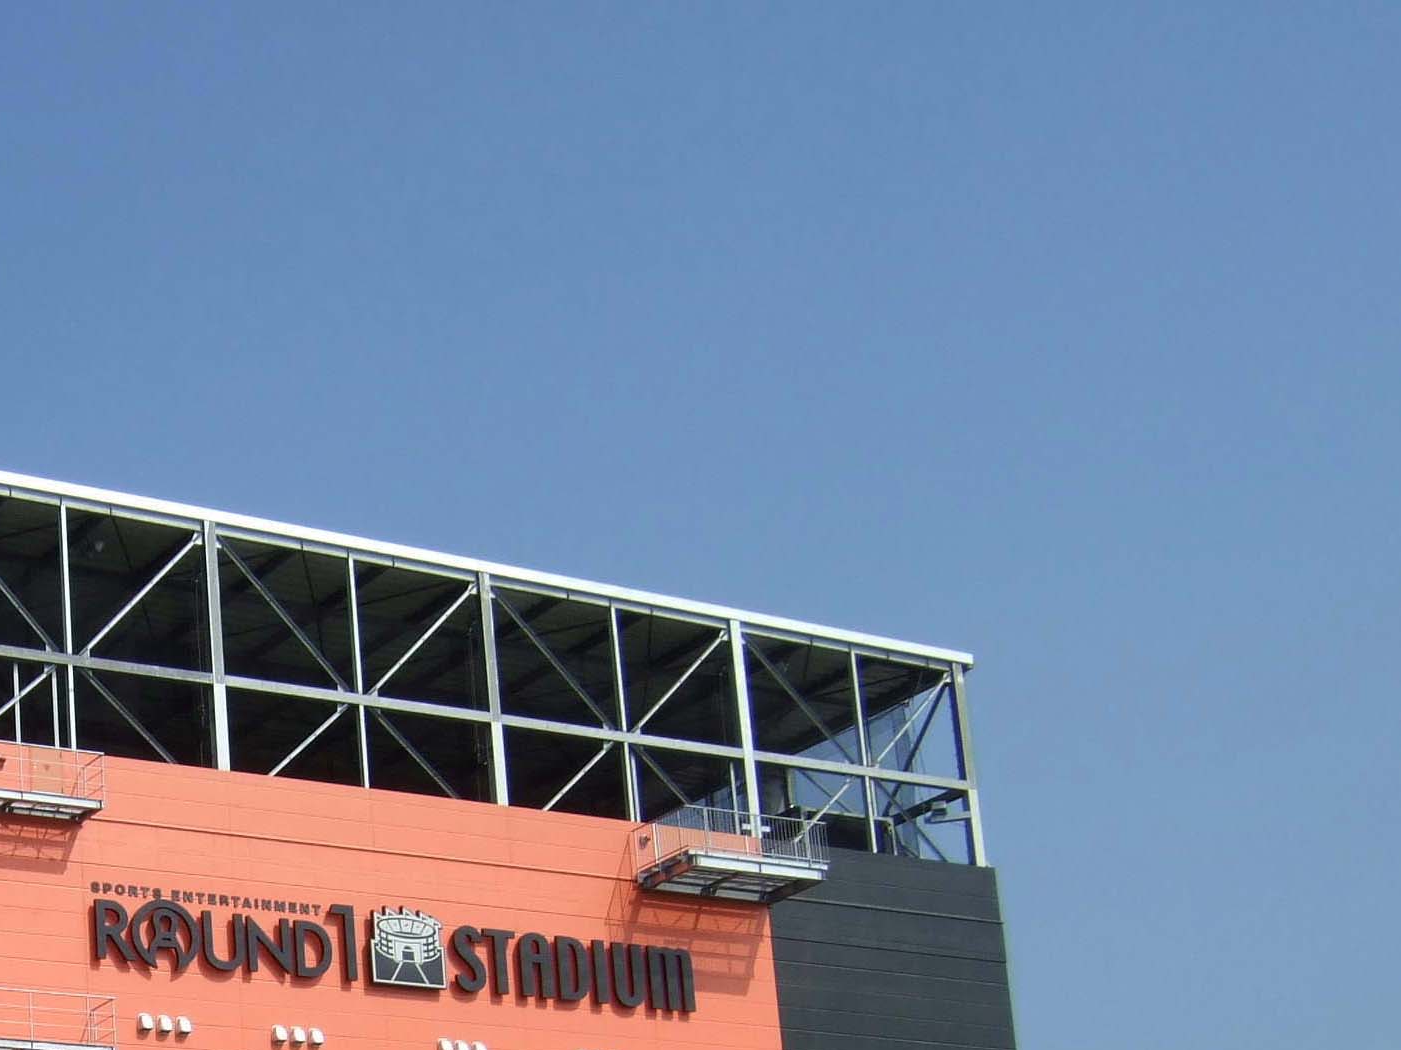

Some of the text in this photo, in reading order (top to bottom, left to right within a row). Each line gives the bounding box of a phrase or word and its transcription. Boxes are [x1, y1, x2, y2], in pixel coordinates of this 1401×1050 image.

[90, 881, 322, 916] SPORTS ENTERTAINMENT
[451, 925, 696, 1013] STADIUM
